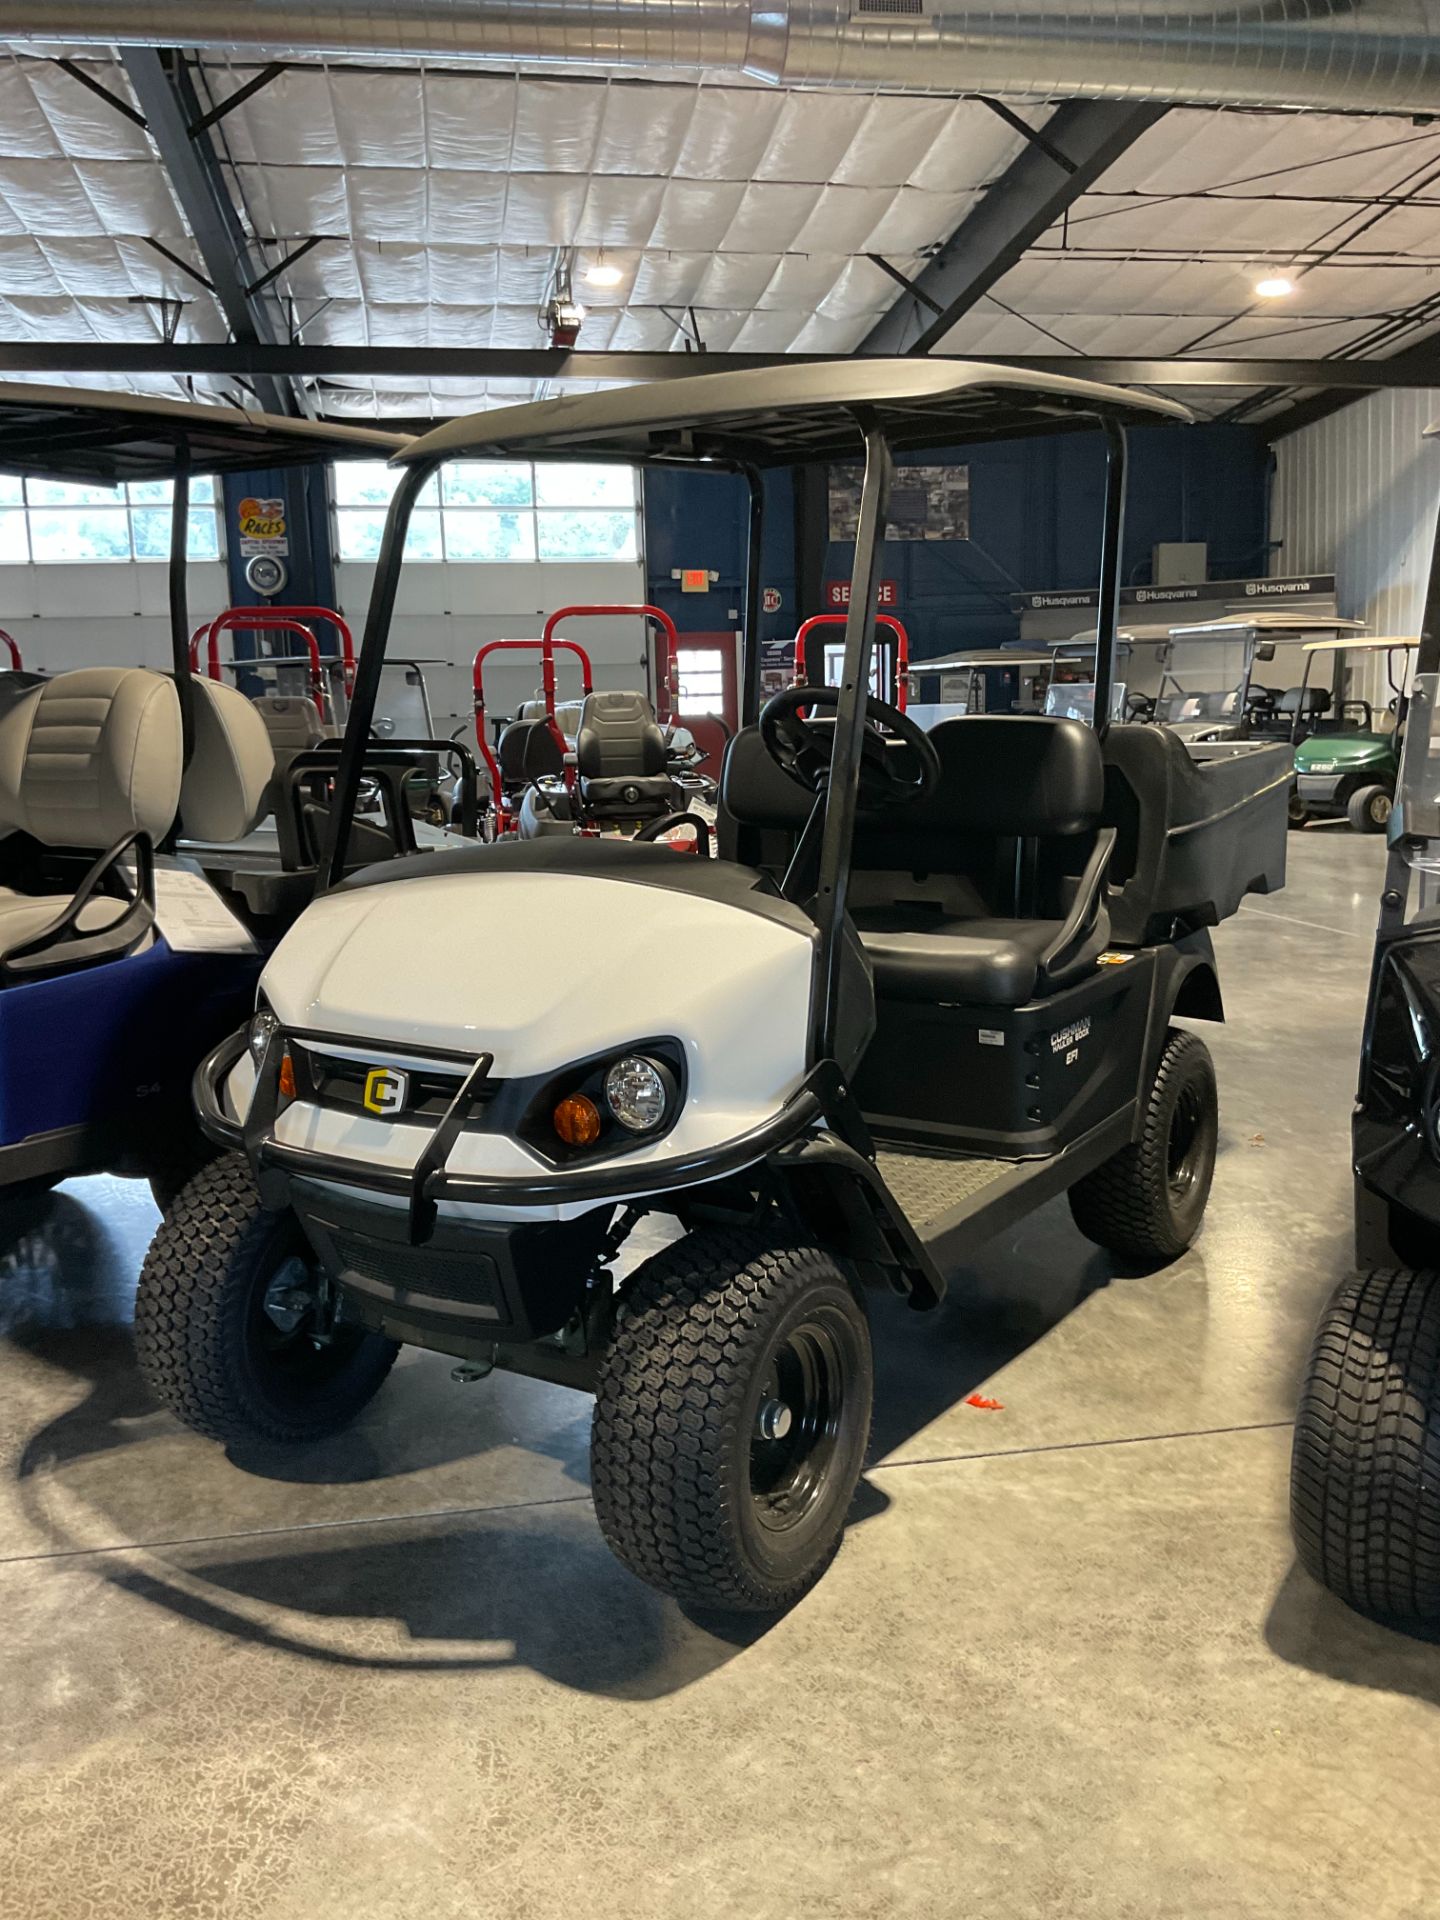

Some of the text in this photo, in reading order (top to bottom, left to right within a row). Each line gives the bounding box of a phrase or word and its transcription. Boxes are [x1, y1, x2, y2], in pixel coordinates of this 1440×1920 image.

[244, 518, 282, 534] RACES
[1146, 589, 1198, 600] Husqvarna
[1256, 582, 1310, 594] Husqvarna
[1042, 596, 1091, 607] Husqvarna
[1051, 1016, 1091, 1046] CUSHMAN
[1066, 1048, 1079, 1065] EFI
